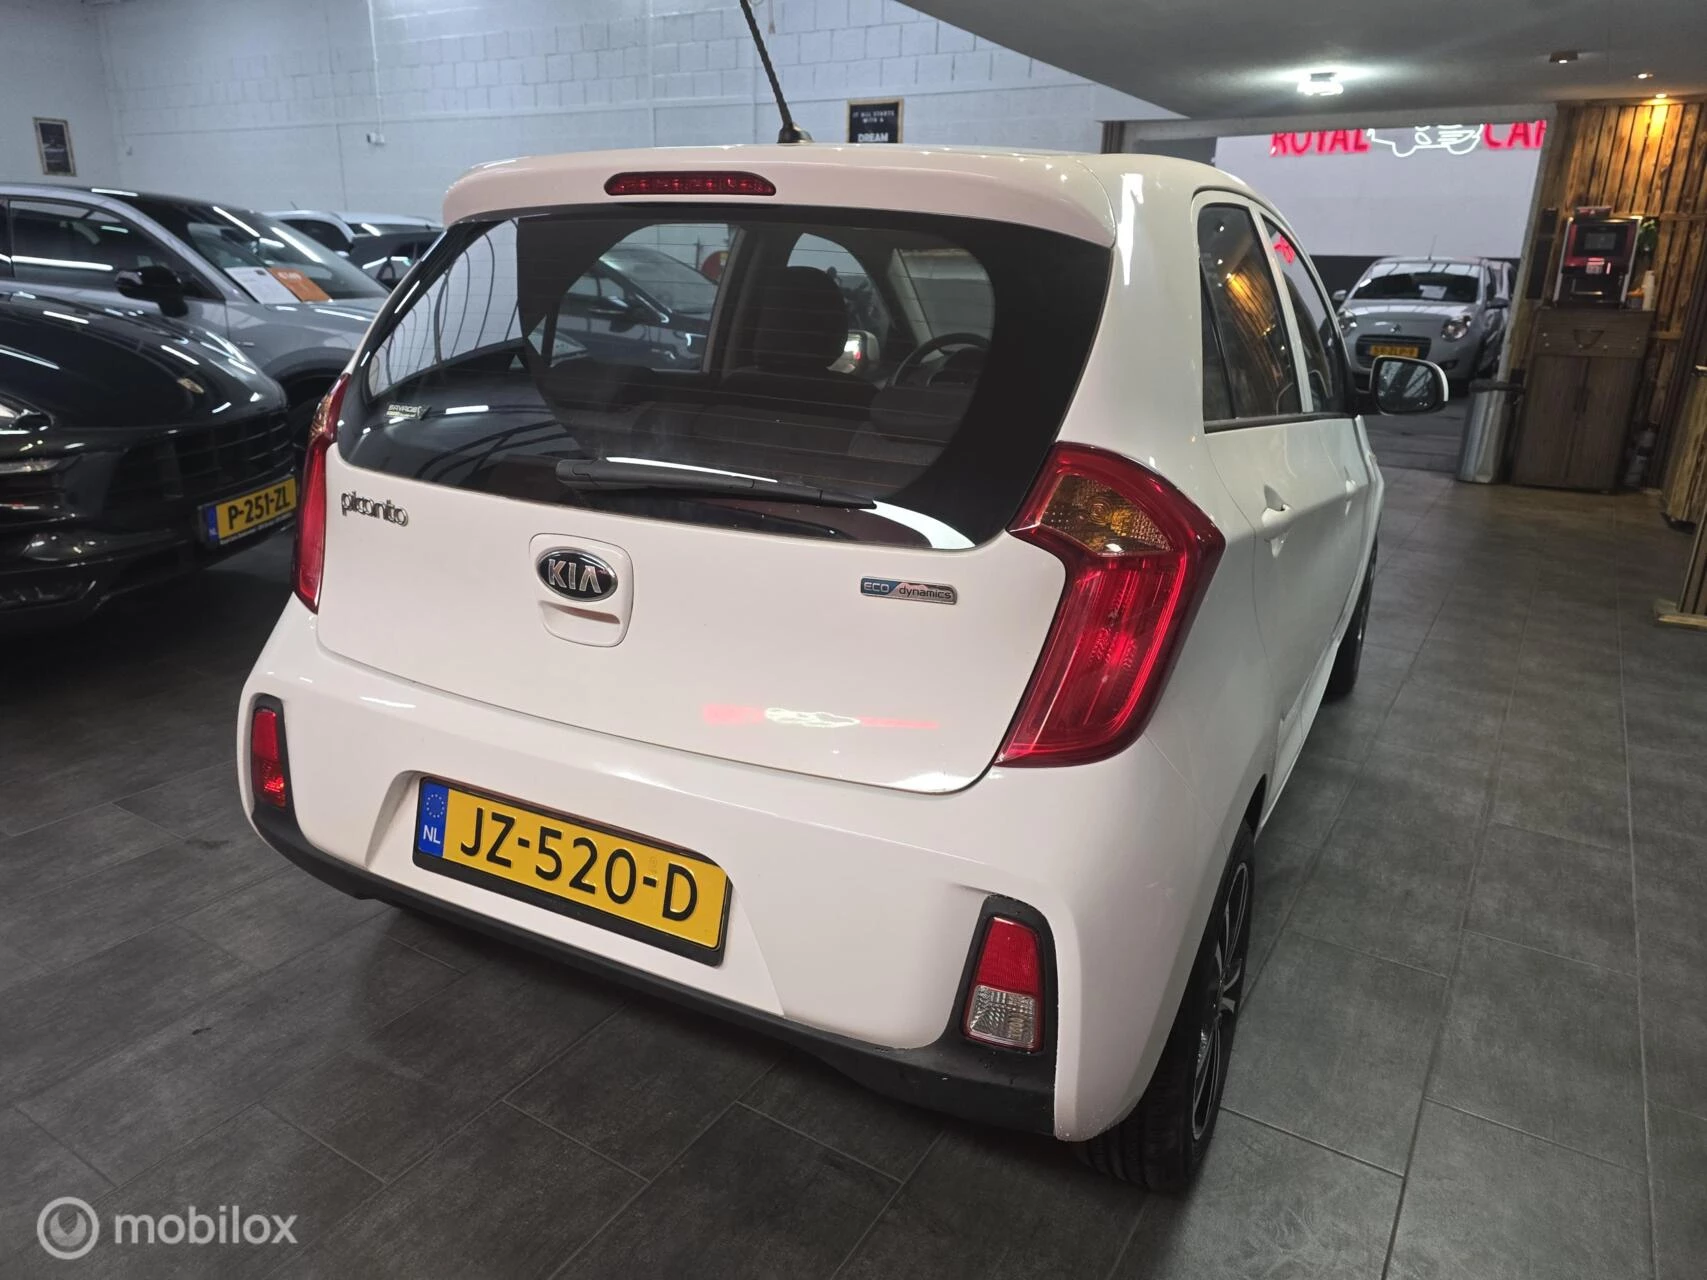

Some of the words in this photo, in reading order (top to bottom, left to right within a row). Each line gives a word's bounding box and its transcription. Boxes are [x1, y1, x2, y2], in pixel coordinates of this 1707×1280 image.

[857, 132, 889, 142] DREAM
[228, 486, 290, 530] P-251-ZL
[548, 559, 602, 594] KIA
[864, 582, 890, 593] ECO
[899, 586, 952, 599] dynamics
[422, 824, 441, 845] NL
[459, 807, 698, 922] JZ-520-D
